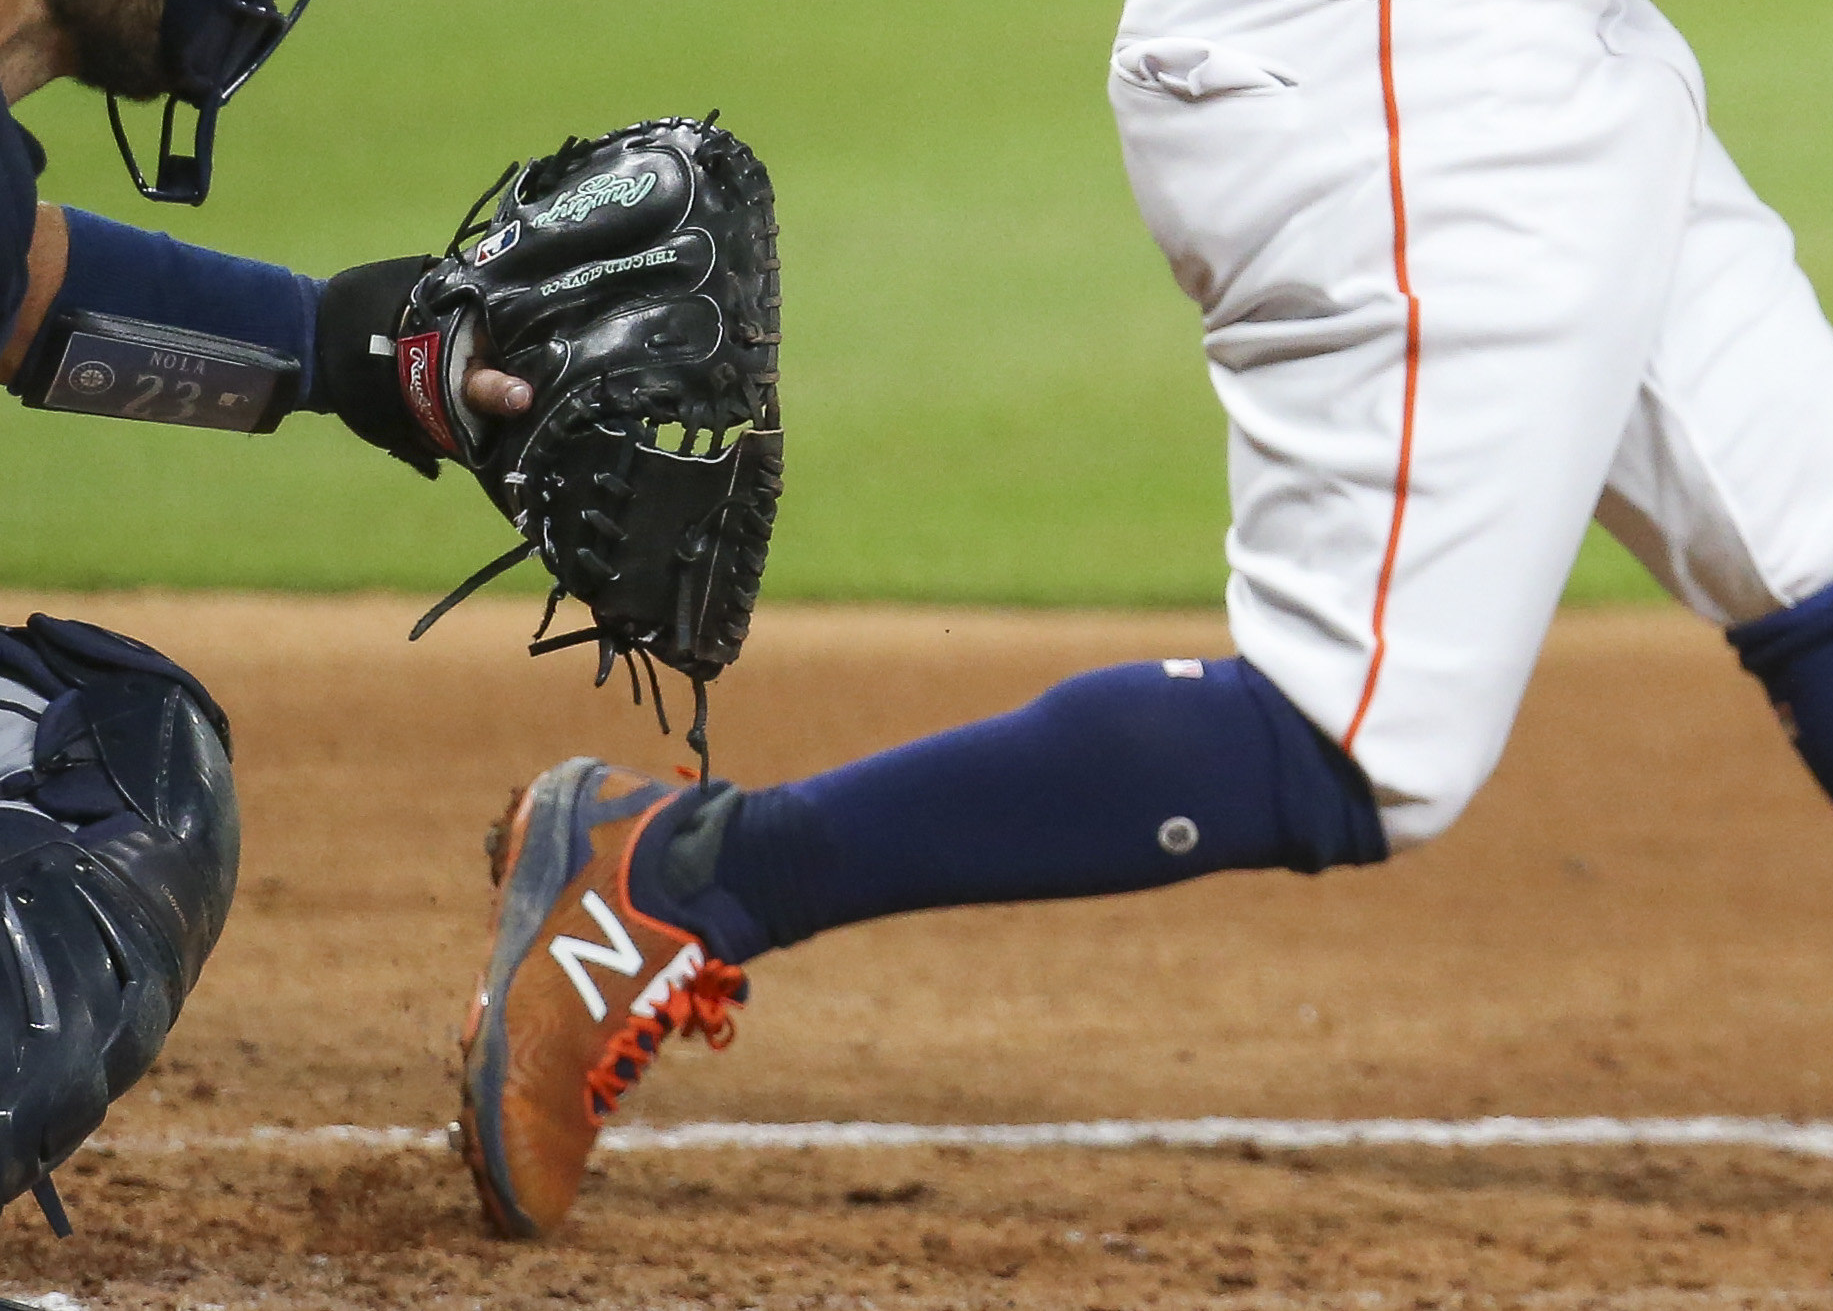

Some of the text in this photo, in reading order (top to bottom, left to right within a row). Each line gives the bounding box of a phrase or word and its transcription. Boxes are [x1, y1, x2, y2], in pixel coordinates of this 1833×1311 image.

[531, 172, 657, 229] Rawlings
[121, 374, 201, 421] 23
[549, 891, 644, 1021] N
